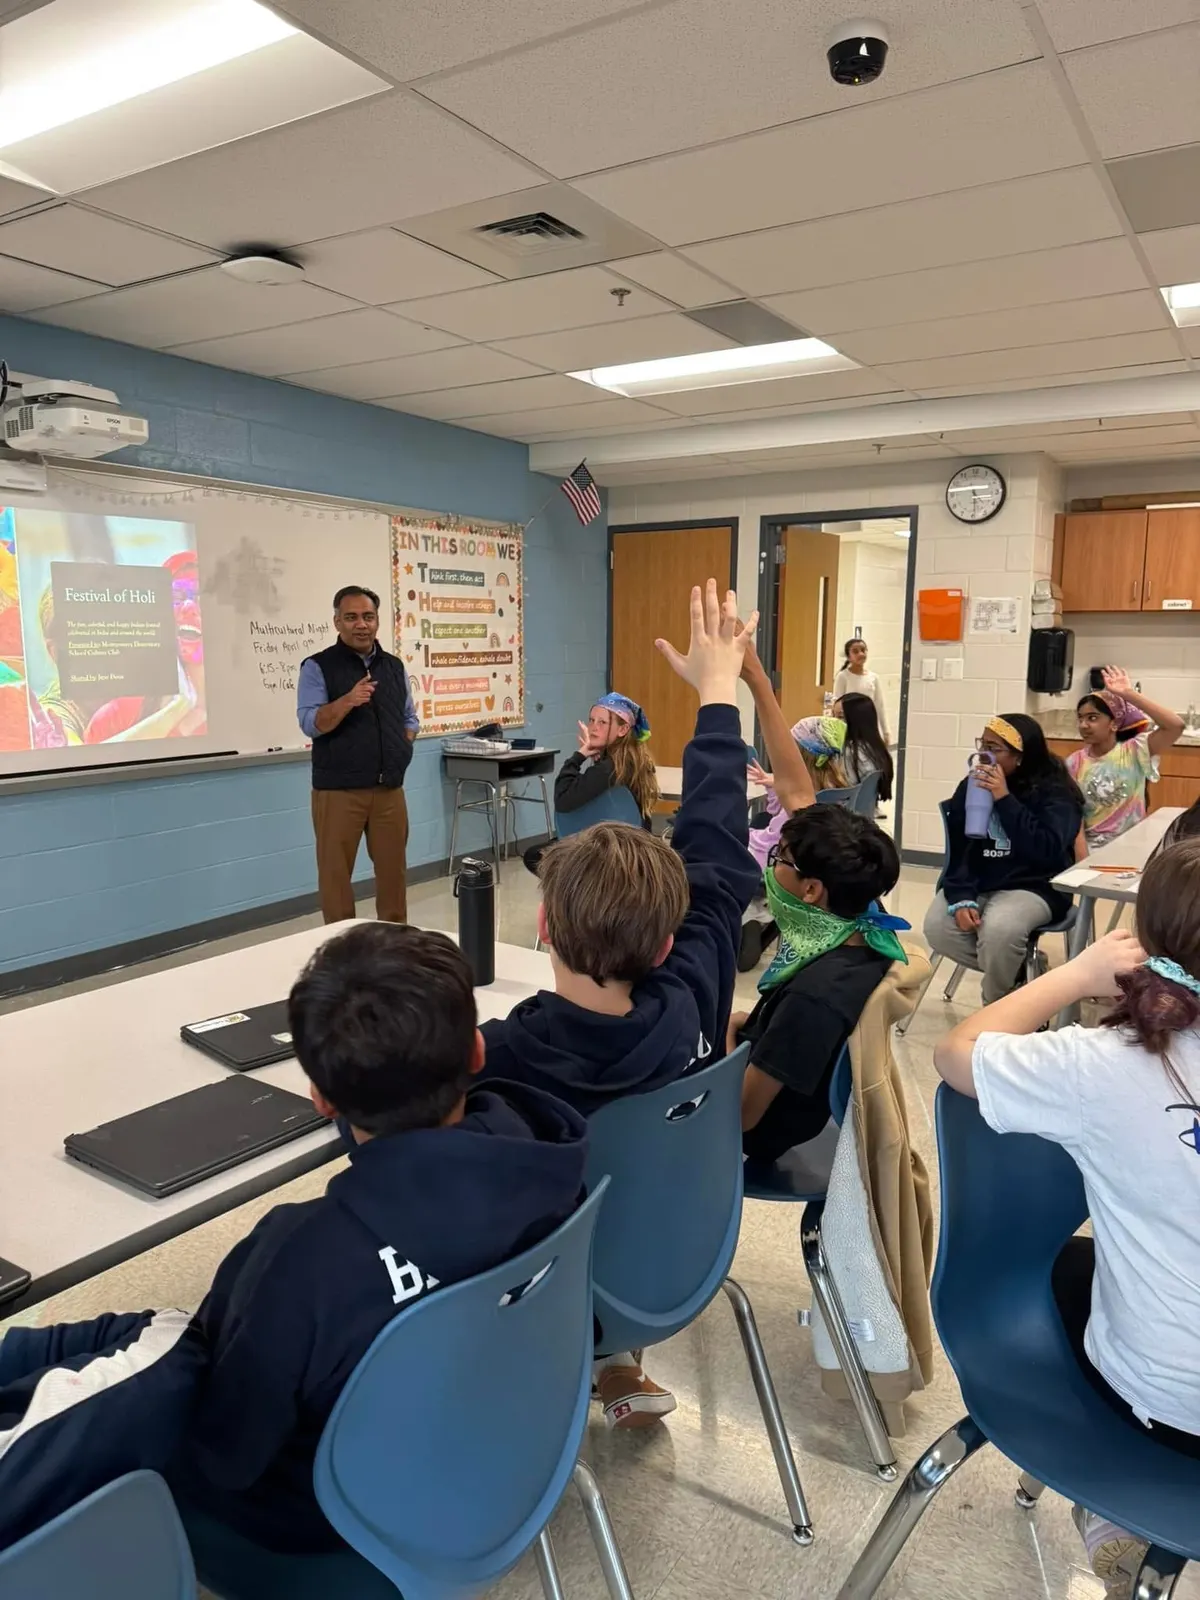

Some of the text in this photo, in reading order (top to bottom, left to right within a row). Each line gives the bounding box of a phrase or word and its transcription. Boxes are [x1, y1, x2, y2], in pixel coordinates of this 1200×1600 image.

[399, 531, 516, 560] IN THIS ROOM WE
[65, 588, 155, 604] Festival of Holi
[250, 621, 329, 641] Multicultural Night
[253, 640, 278, 654] Friday
[282, 640, 300, 656] April
